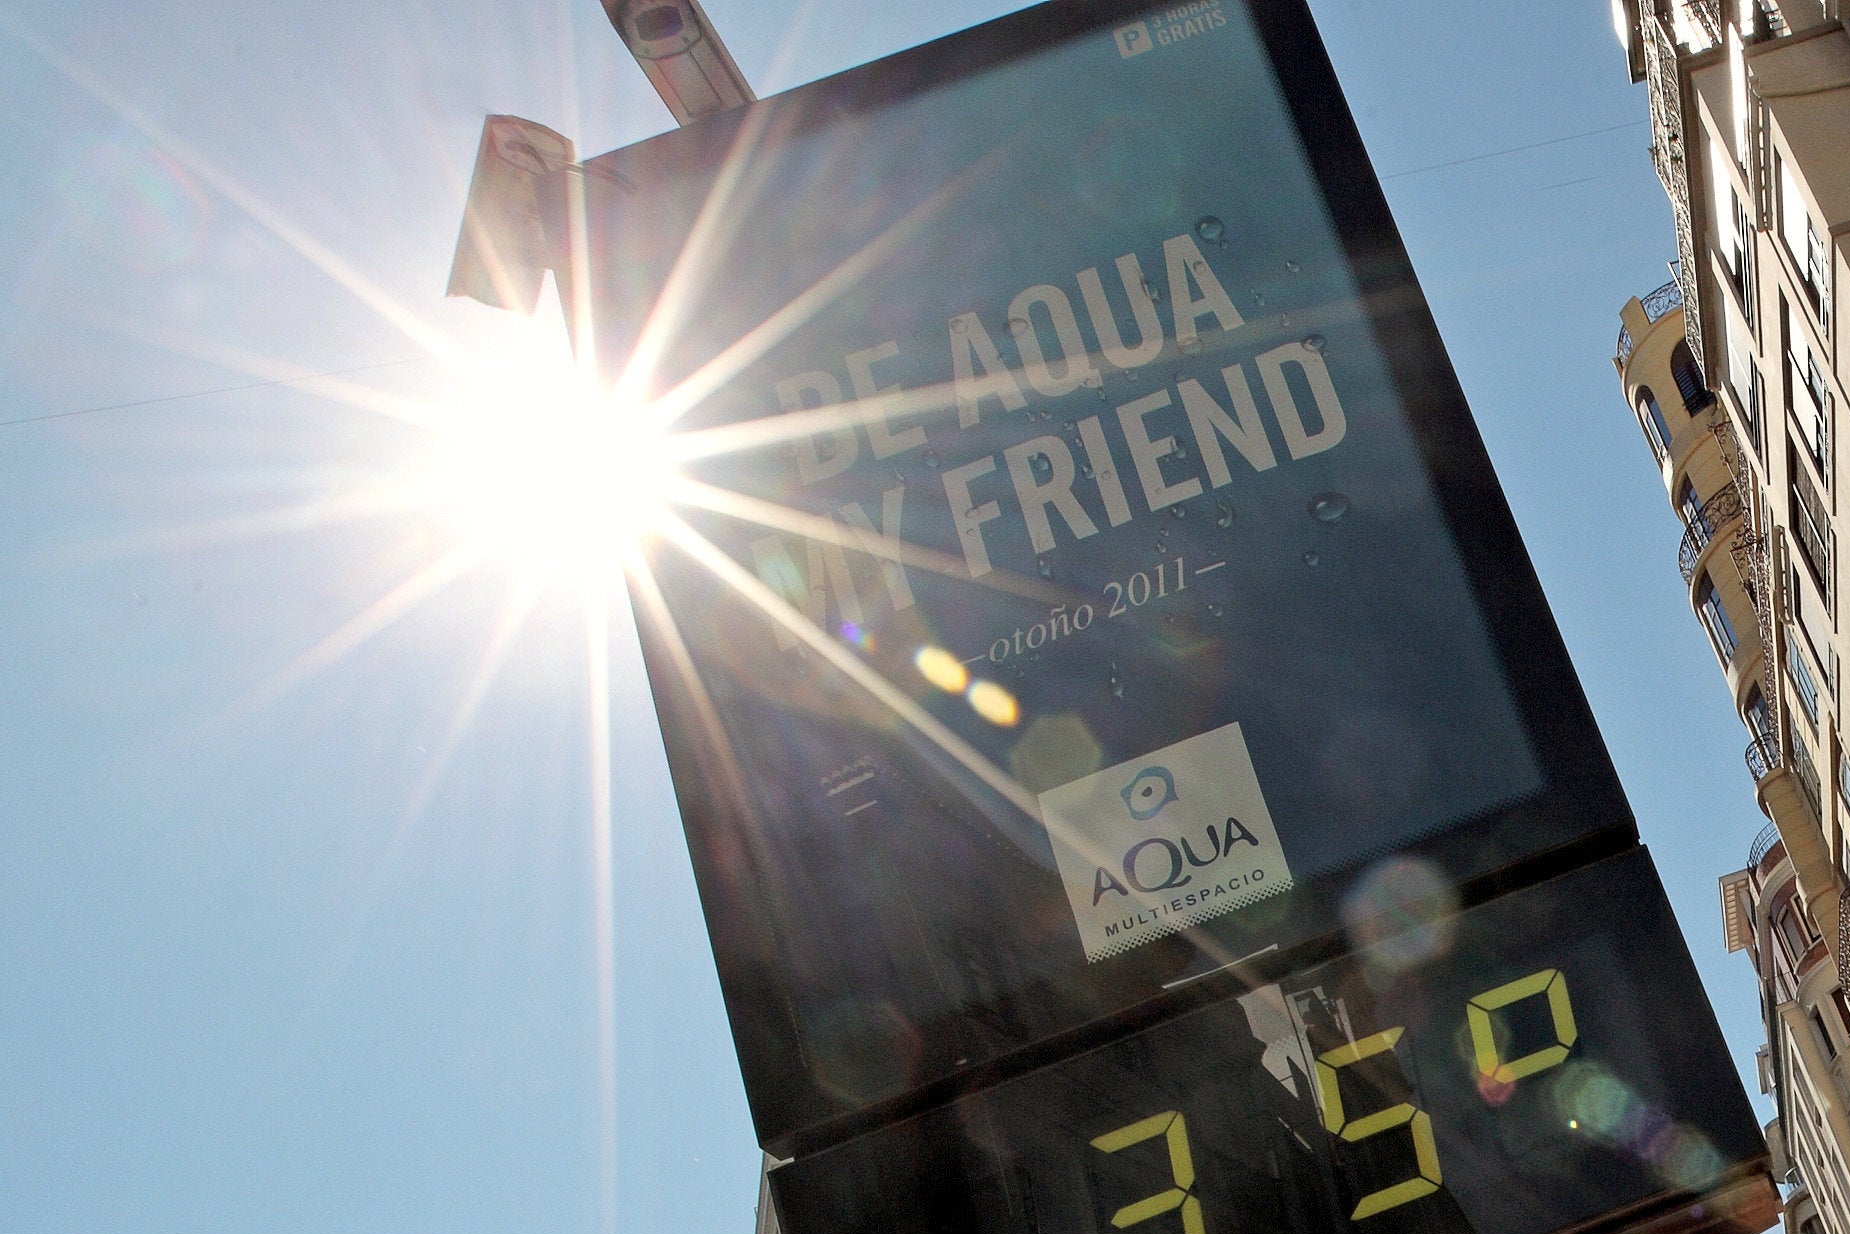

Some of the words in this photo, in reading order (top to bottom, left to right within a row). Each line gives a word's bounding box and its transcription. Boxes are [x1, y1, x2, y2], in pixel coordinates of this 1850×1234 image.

[1156, 9, 1228, 46] GRATIS
[775, 339, 929, 487] BE
[948, 232, 1247, 430] AQUA
[749, 487, 916, 655] MY
[941, 341, 1348, 580] FRIEND
[1092, 816, 1260, 908] AQUA
[1104, 868, 1266, 938] MULTIESPACIO
